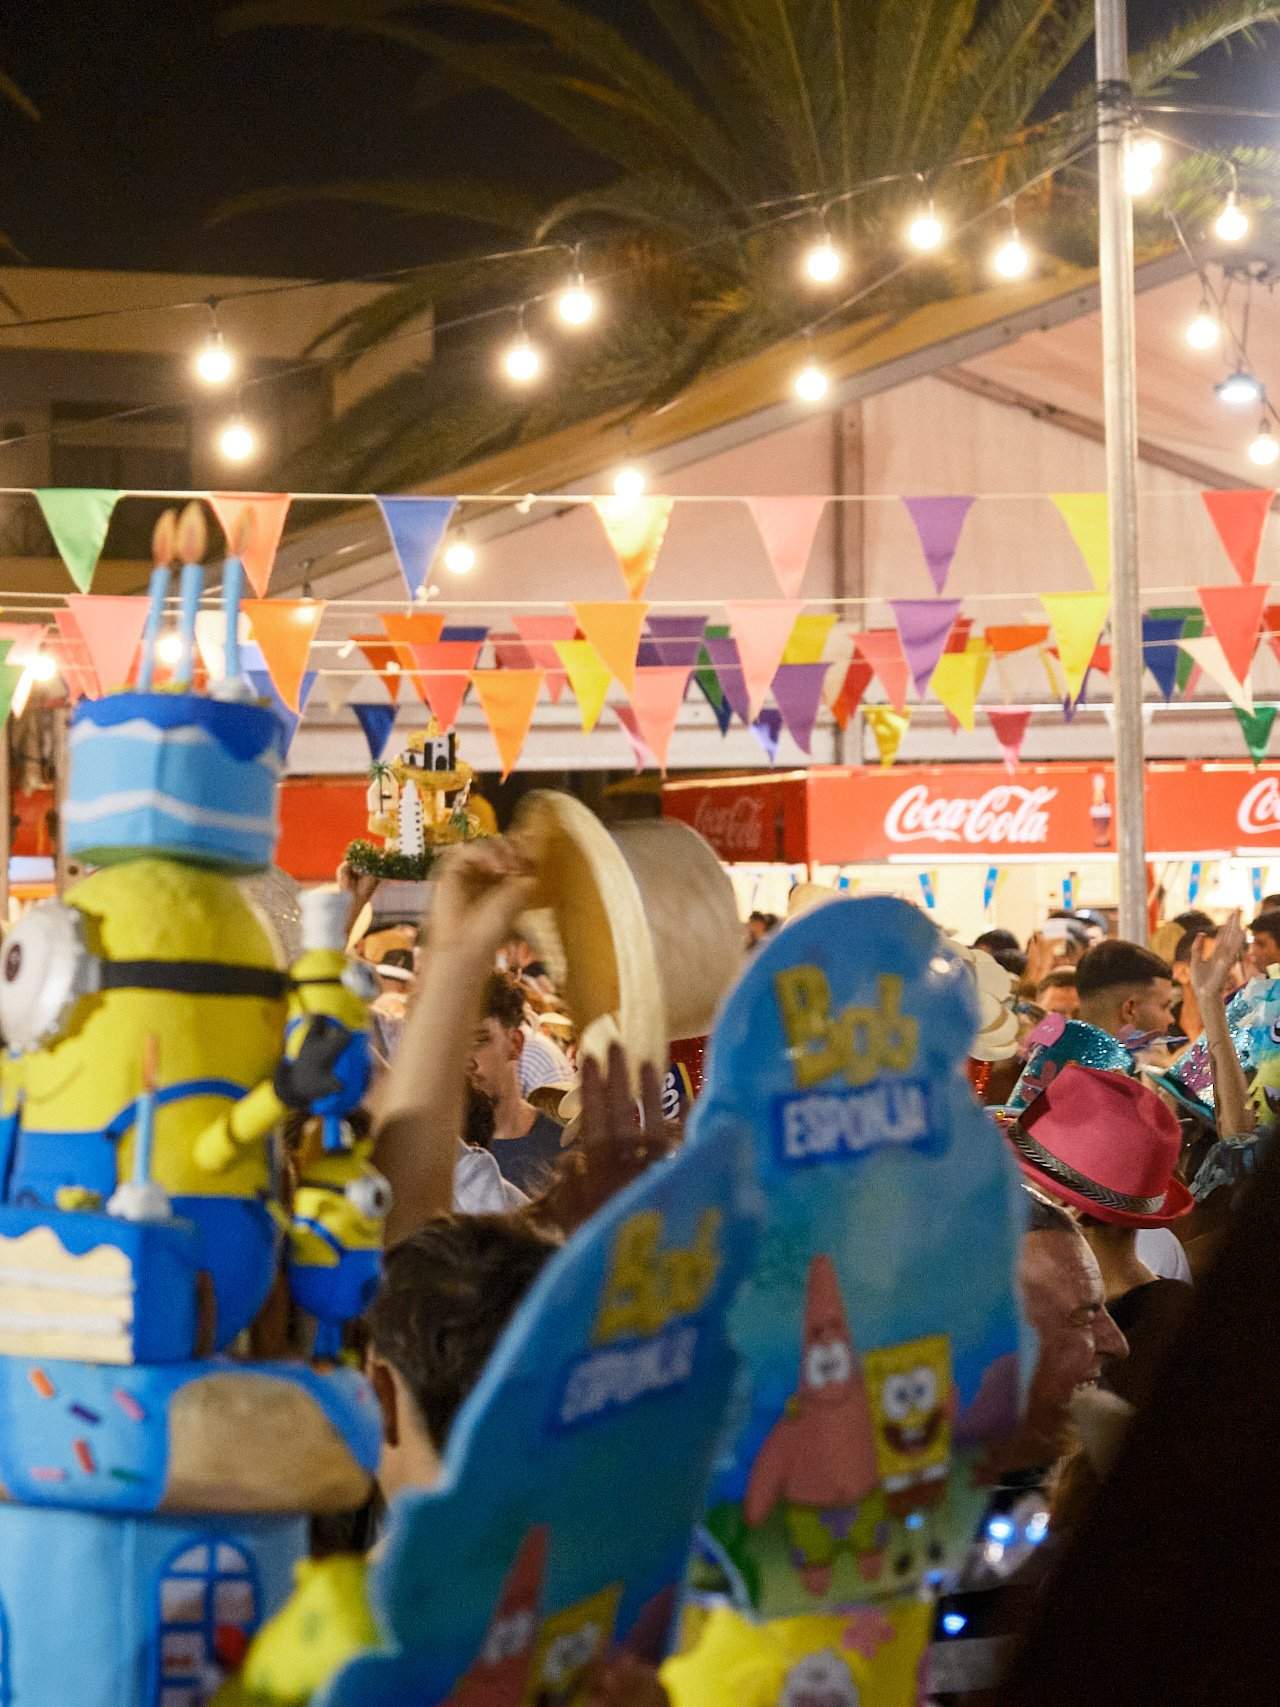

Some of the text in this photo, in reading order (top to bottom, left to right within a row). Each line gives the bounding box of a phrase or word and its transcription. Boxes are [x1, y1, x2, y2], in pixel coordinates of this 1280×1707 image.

[883, 784, 1059, 843] Coca-Cola
[775, 964, 919, 1088] Bob
[783, 1084, 927, 1158] ESPONJA
